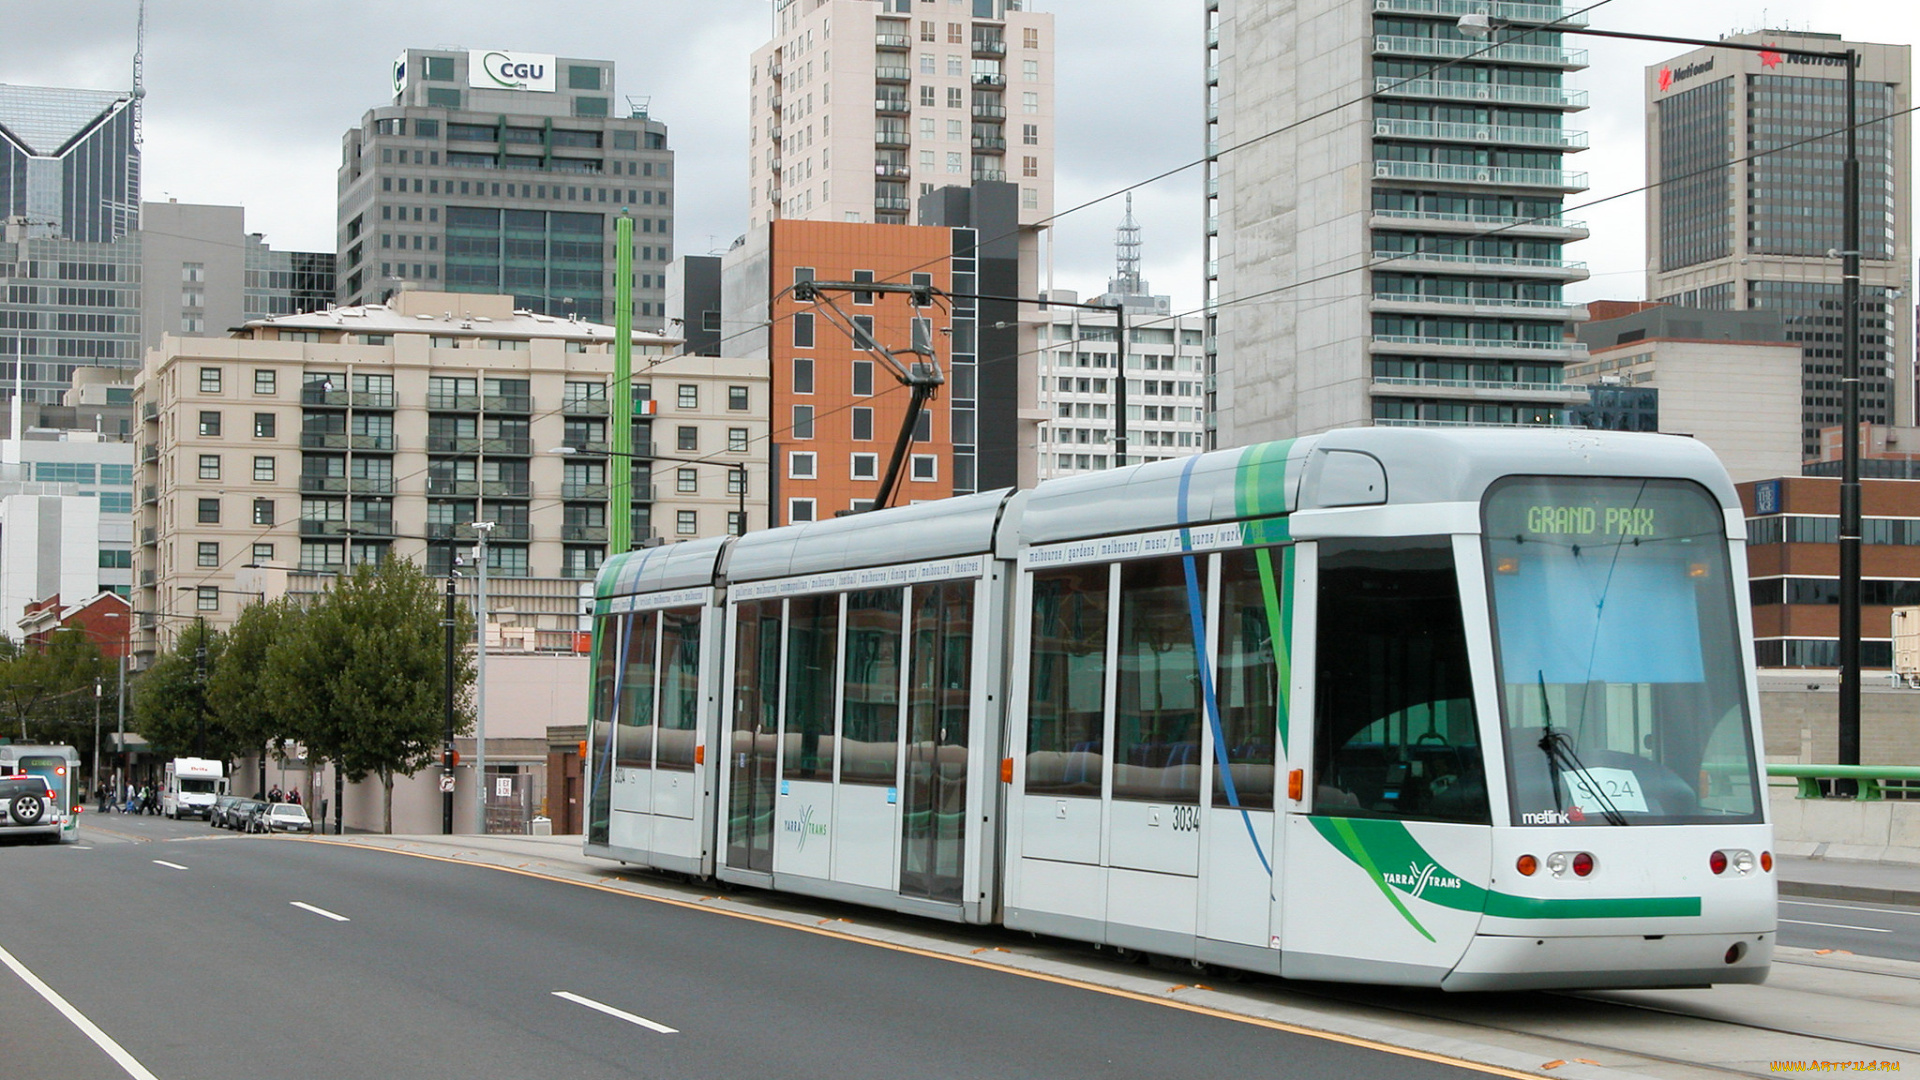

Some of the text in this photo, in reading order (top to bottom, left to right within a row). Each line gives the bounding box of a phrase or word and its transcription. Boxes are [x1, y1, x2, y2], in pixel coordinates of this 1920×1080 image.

[500, 63, 544, 80] CGU
[1673, 55, 1714, 83] National
[1786, 53, 1862, 68] Nationl
[1528, 506, 1654, 535] GRAND PRIX
[1029, 548, 1062, 562] melbourne
[1068, 543, 1094, 561] gardens
[1101, 540, 1138, 555] melbourne
[1145, 535, 1167, 550] music
[1174, 531, 1214, 547] mourne
[1220, 525, 1240, 541] work
[811, 576, 835, 588] melbourne
[861, 570, 887, 583] melbourne
[891, 567, 907, 581] dining
[908, 567, 917, 578] out
[921, 563, 950, 577] melbourne
[954, 560, 978, 573] theatres
[784, 820, 827, 835] YARRA TRAMS
[1172, 805, 1199, 832] 3034
[1522, 810, 1570, 824] metlink
[1383, 872, 1461, 889] YARRA TRAMS
